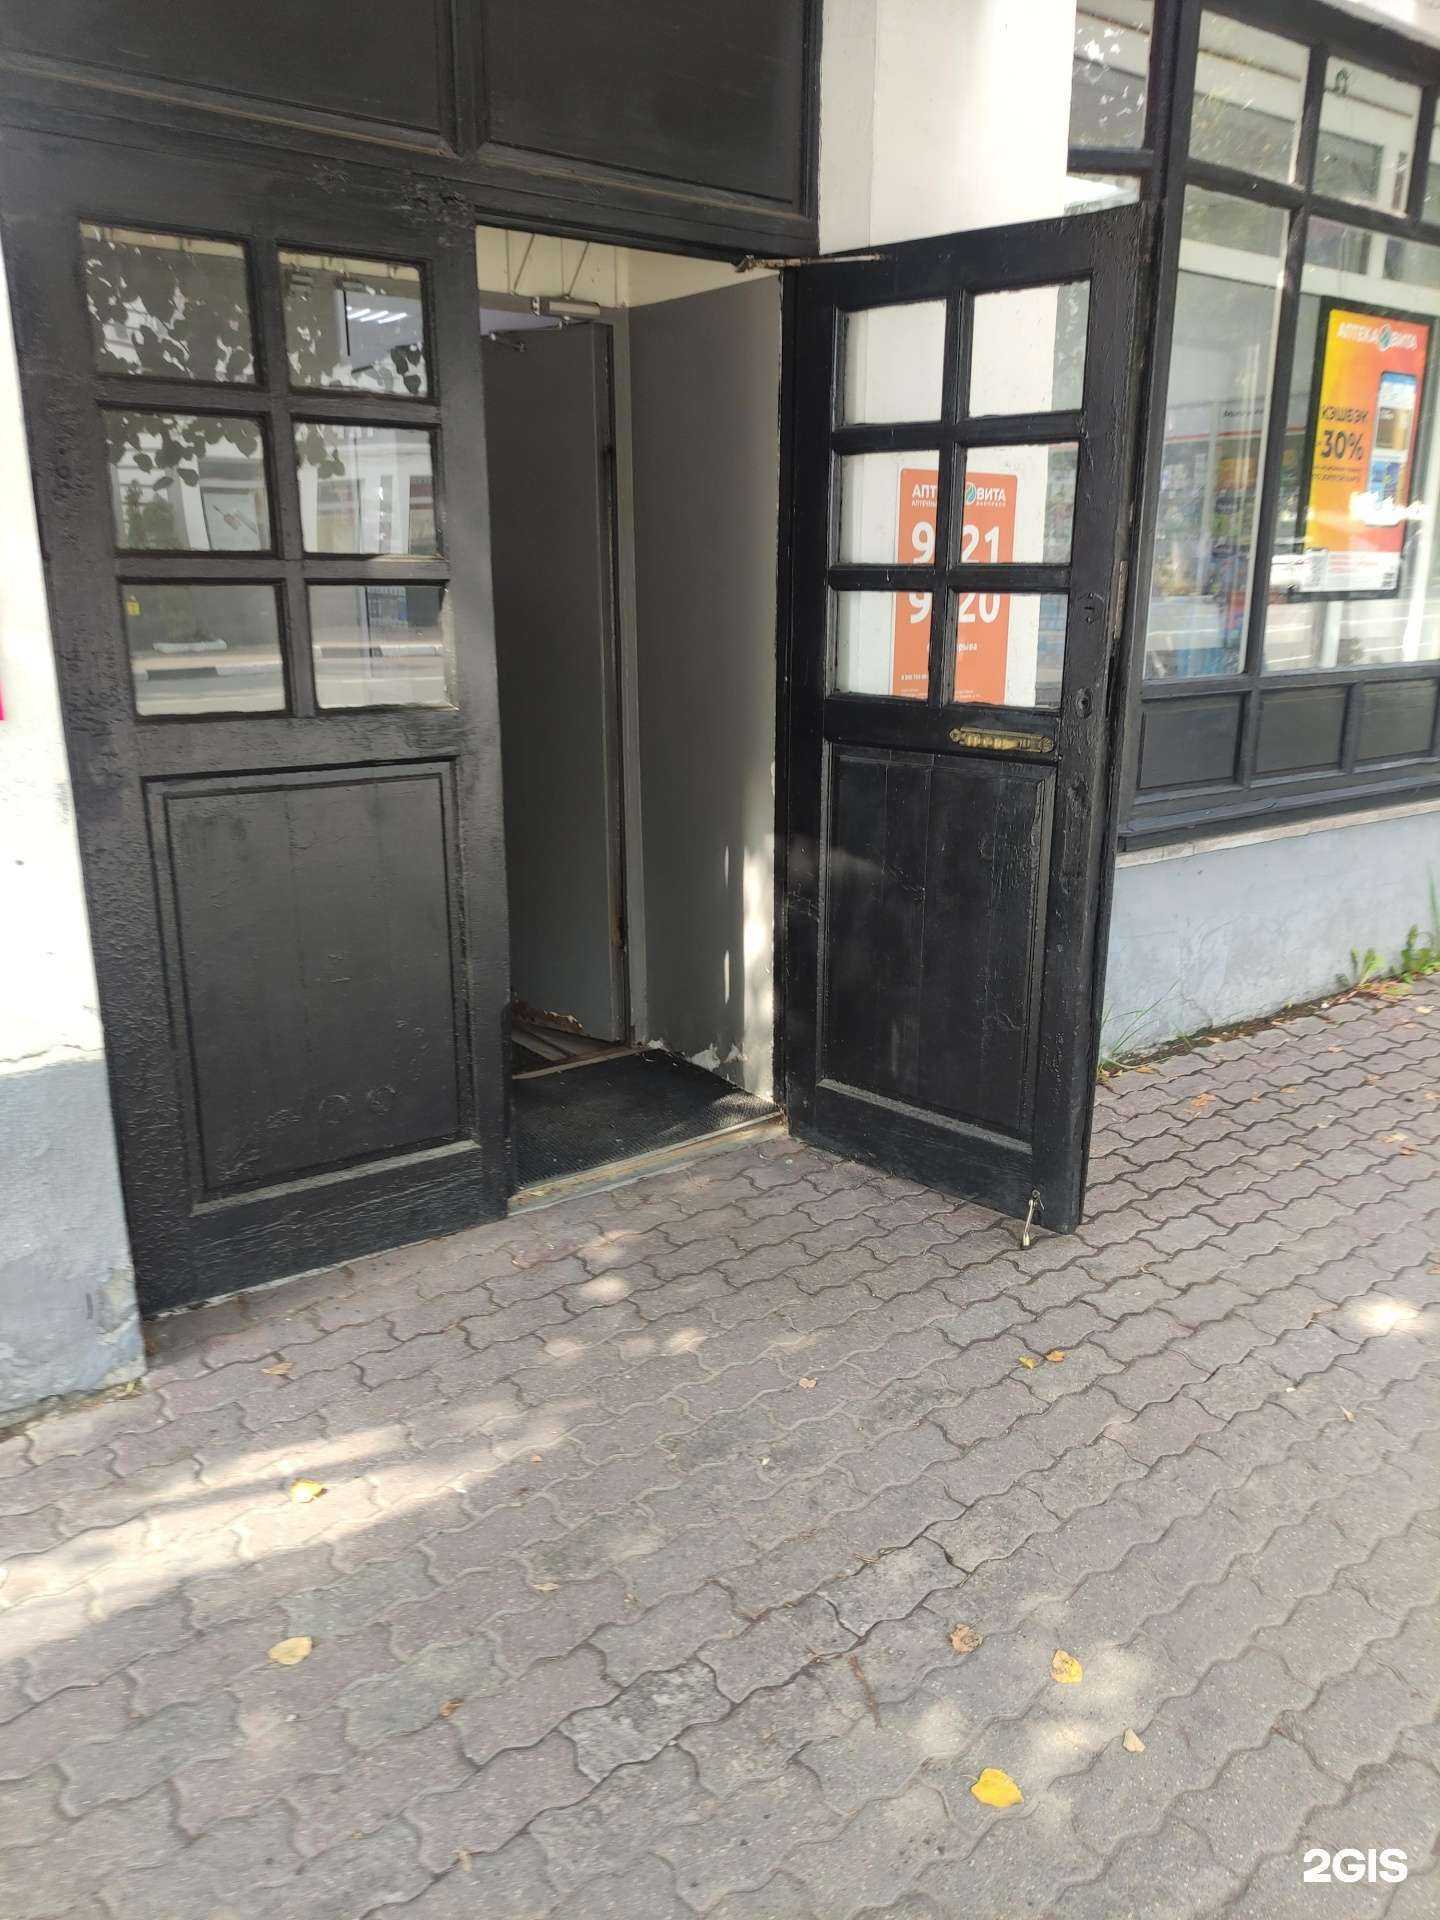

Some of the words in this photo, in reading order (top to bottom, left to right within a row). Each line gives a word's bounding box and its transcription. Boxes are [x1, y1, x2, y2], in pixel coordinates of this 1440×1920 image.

[1336, 322, 1379, 344] АПТЕКА
[911, 484, 938, 499] АПТ
[976, 486, 1007, 502] ВИТА
